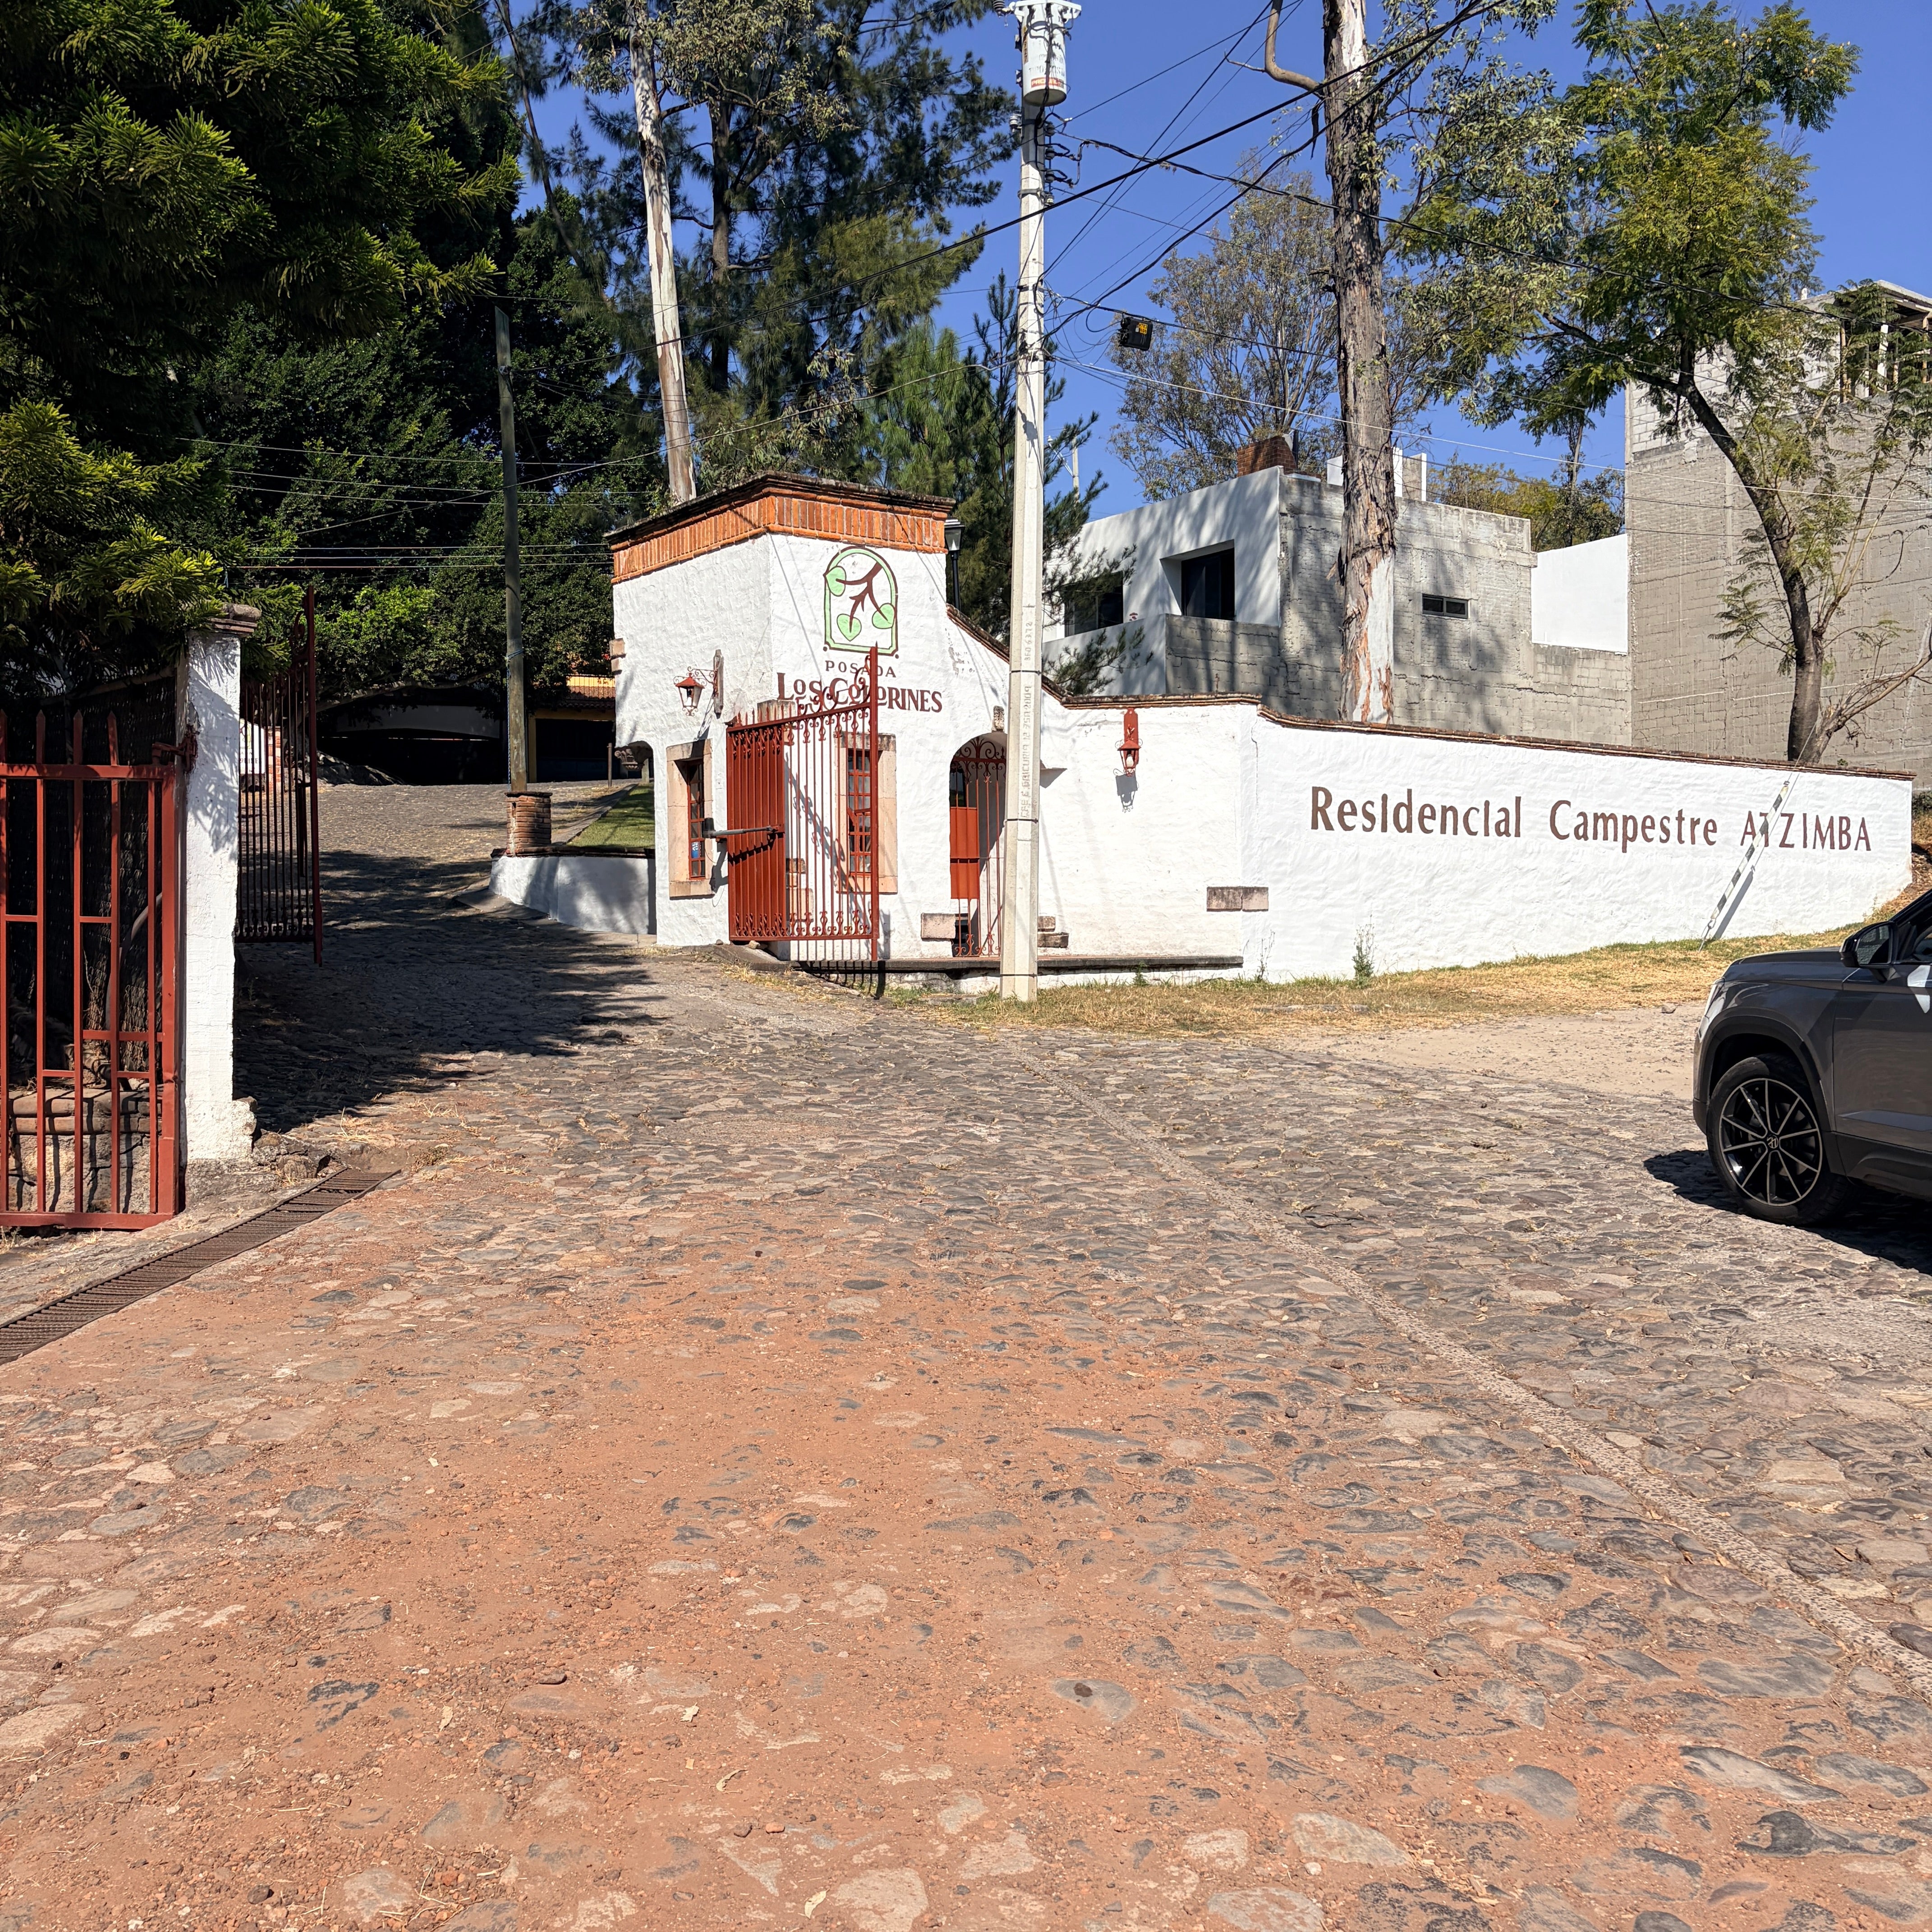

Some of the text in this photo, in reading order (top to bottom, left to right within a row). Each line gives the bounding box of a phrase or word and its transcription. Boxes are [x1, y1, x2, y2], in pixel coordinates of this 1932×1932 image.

[826, 660, 897, 678] POSADA
[1311, 786, 1871, 853] Residencial Campestre ATZIMBA
